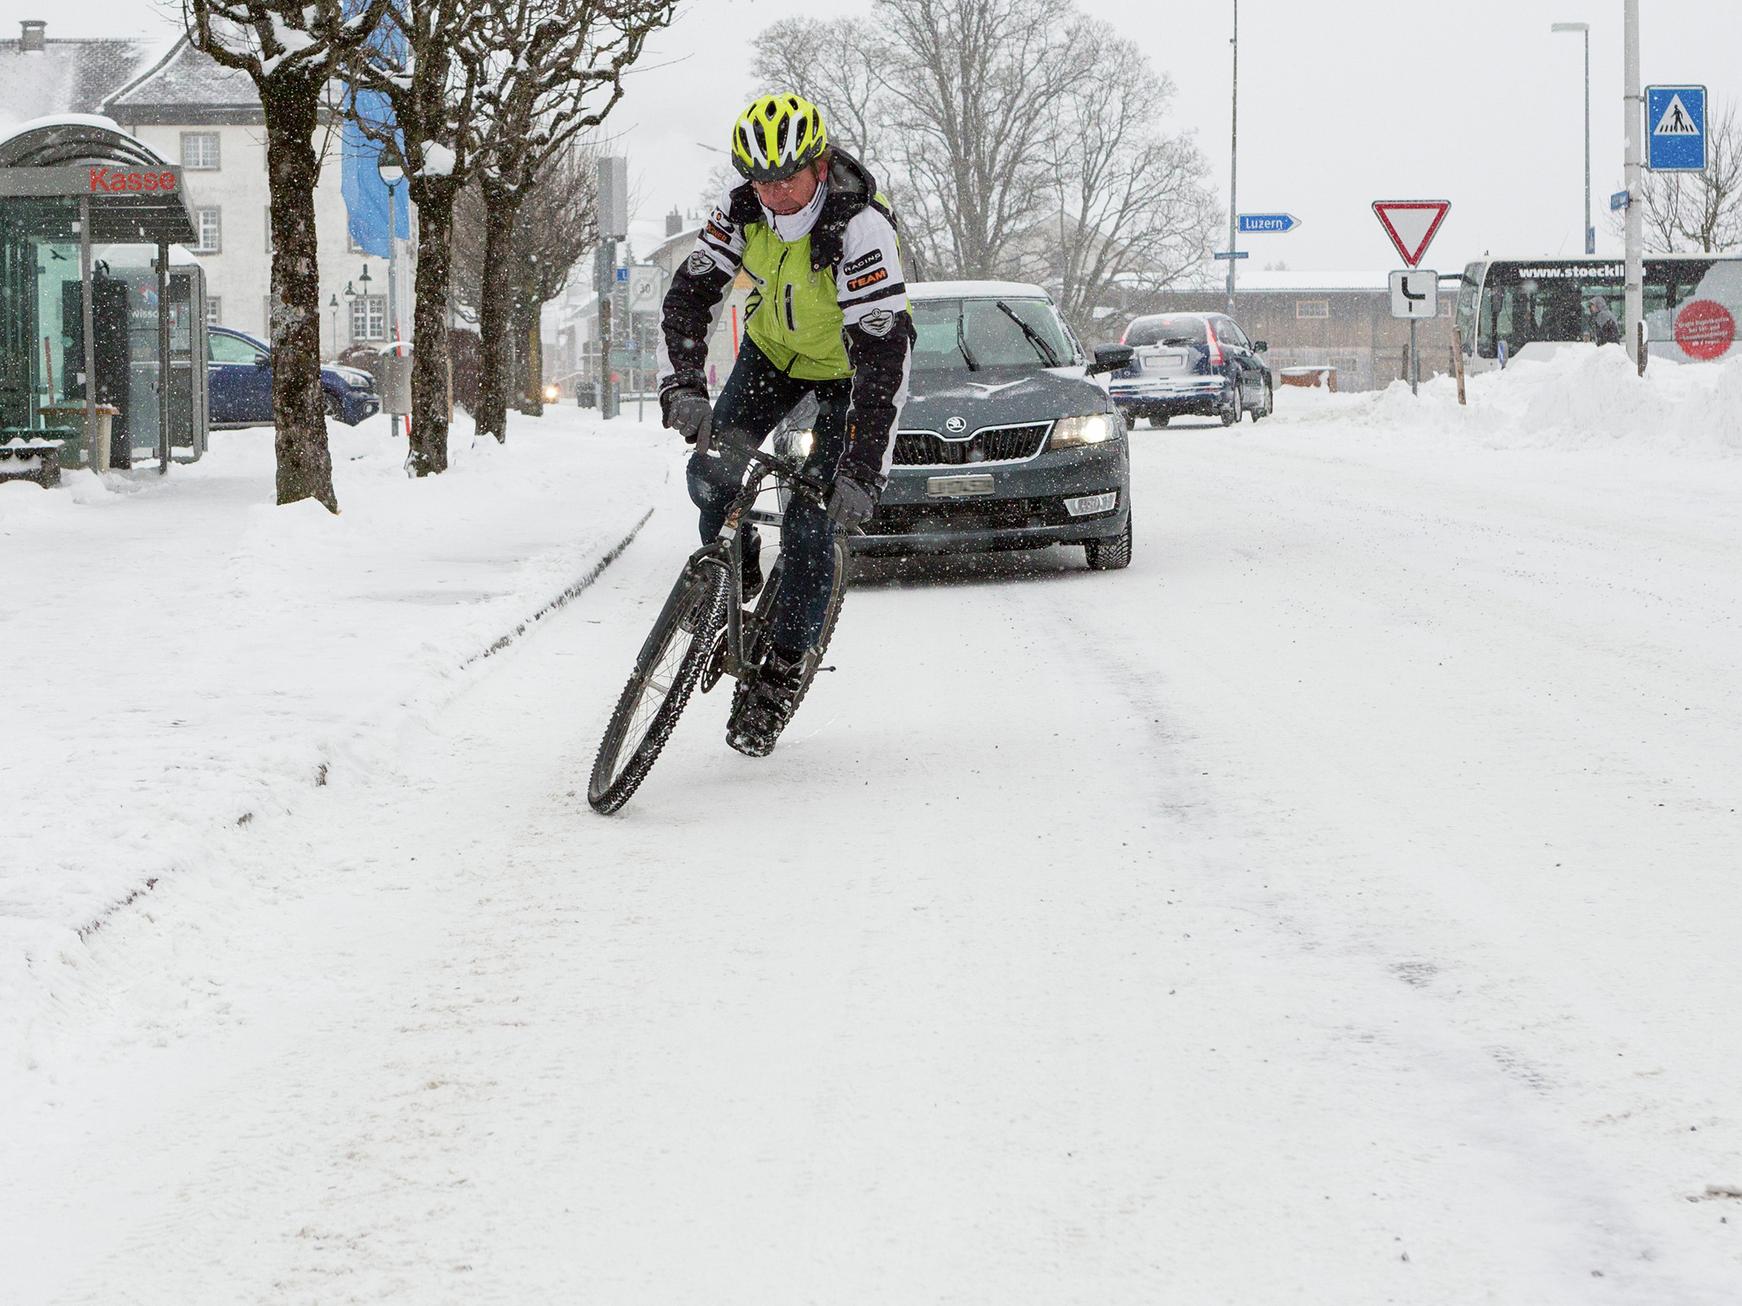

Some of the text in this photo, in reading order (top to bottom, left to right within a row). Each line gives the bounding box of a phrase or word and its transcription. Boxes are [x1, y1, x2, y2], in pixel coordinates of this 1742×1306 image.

[89, 167, 176, 192] Kasse
[1245, 217, 1284, 230] Luzern
[844, 252, 881, 272] RACING
[1518, 264, 1646, 278] www.stoeckli
[848, 270, 887, 289] TEAM
[639, 283, 651, 294] 30
